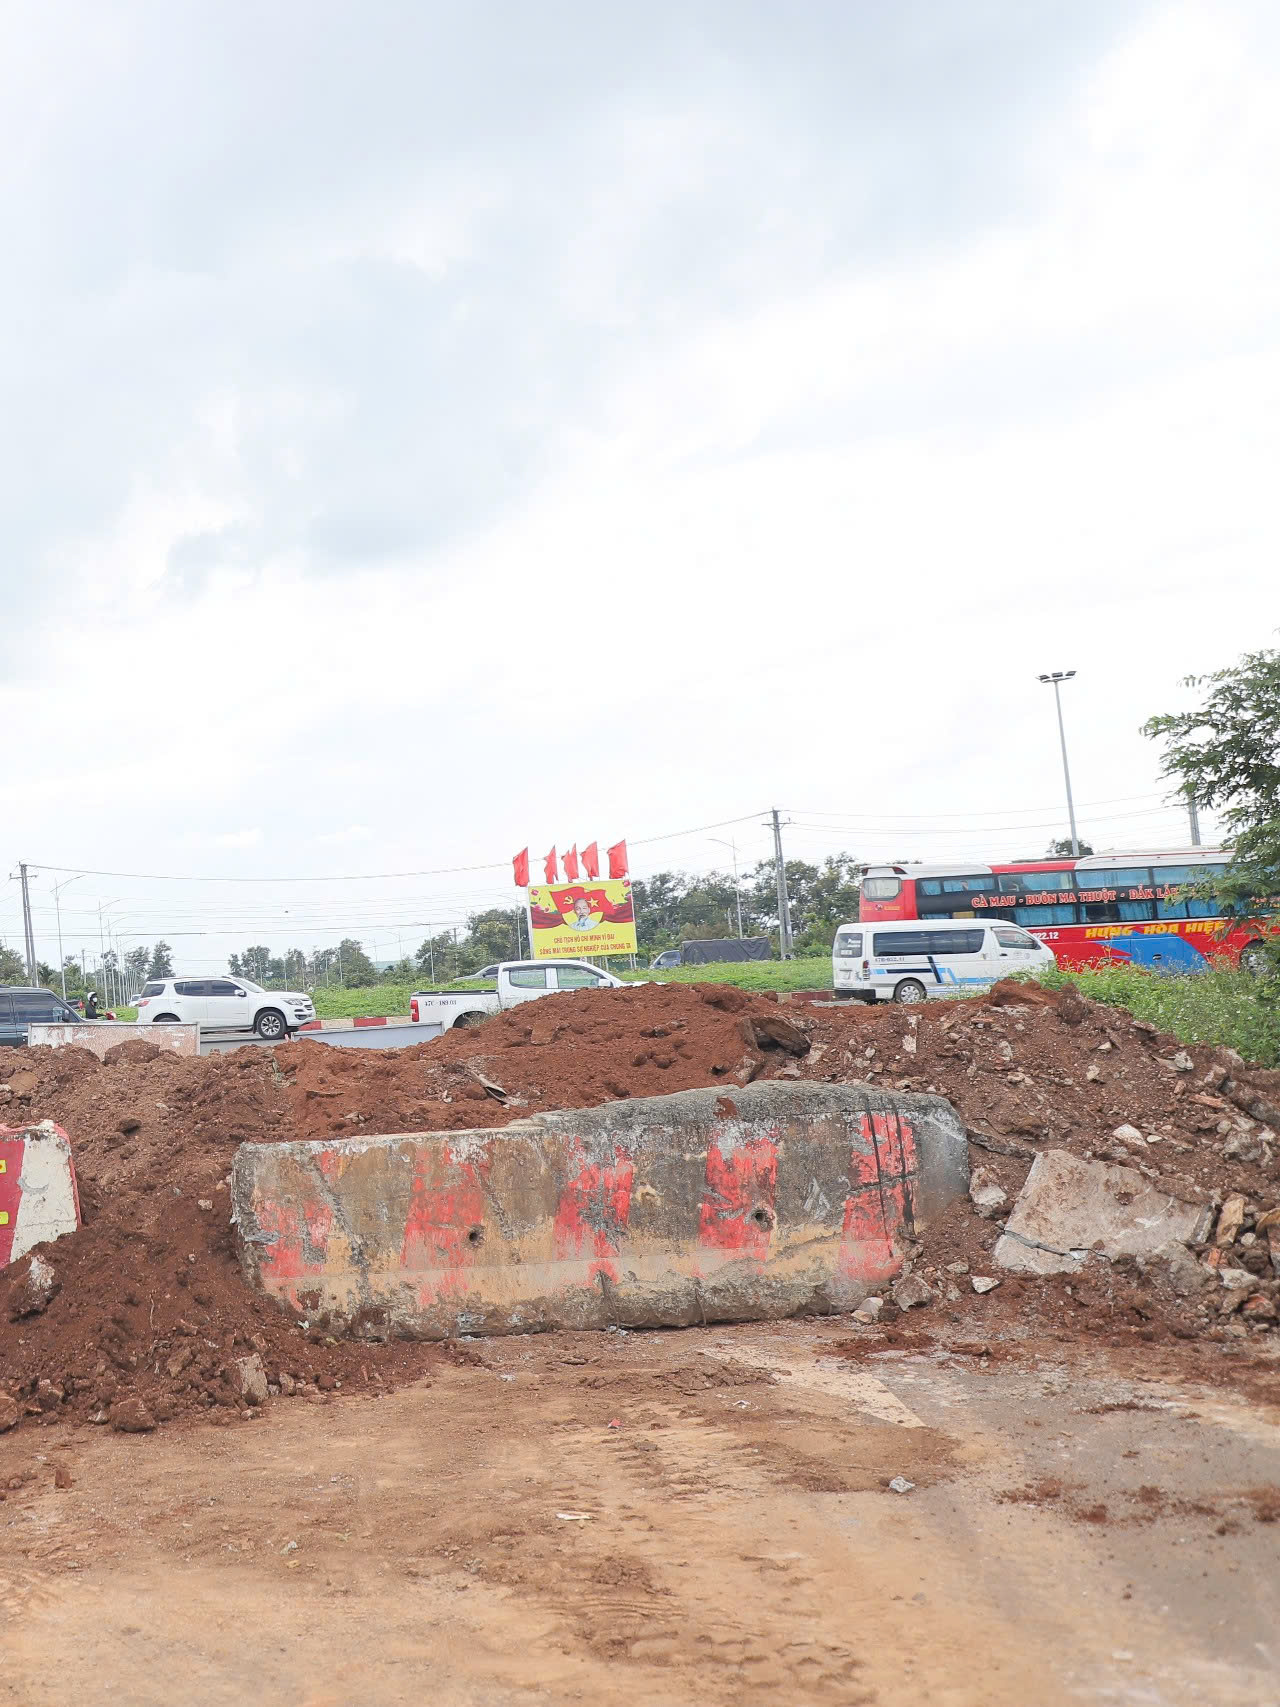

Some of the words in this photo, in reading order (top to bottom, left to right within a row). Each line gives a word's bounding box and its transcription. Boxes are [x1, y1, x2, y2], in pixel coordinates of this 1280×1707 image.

[971, 894, 988, 908] CÀ
[990, 895, 1016, 908] MAU
[1025, 891, 1057, 906] BUÔN
[1058, 891, 1077, 904] MA
[1078, 888, 1117, 904] THUỘT
[1031, 931, 1059, 940] 22.12
